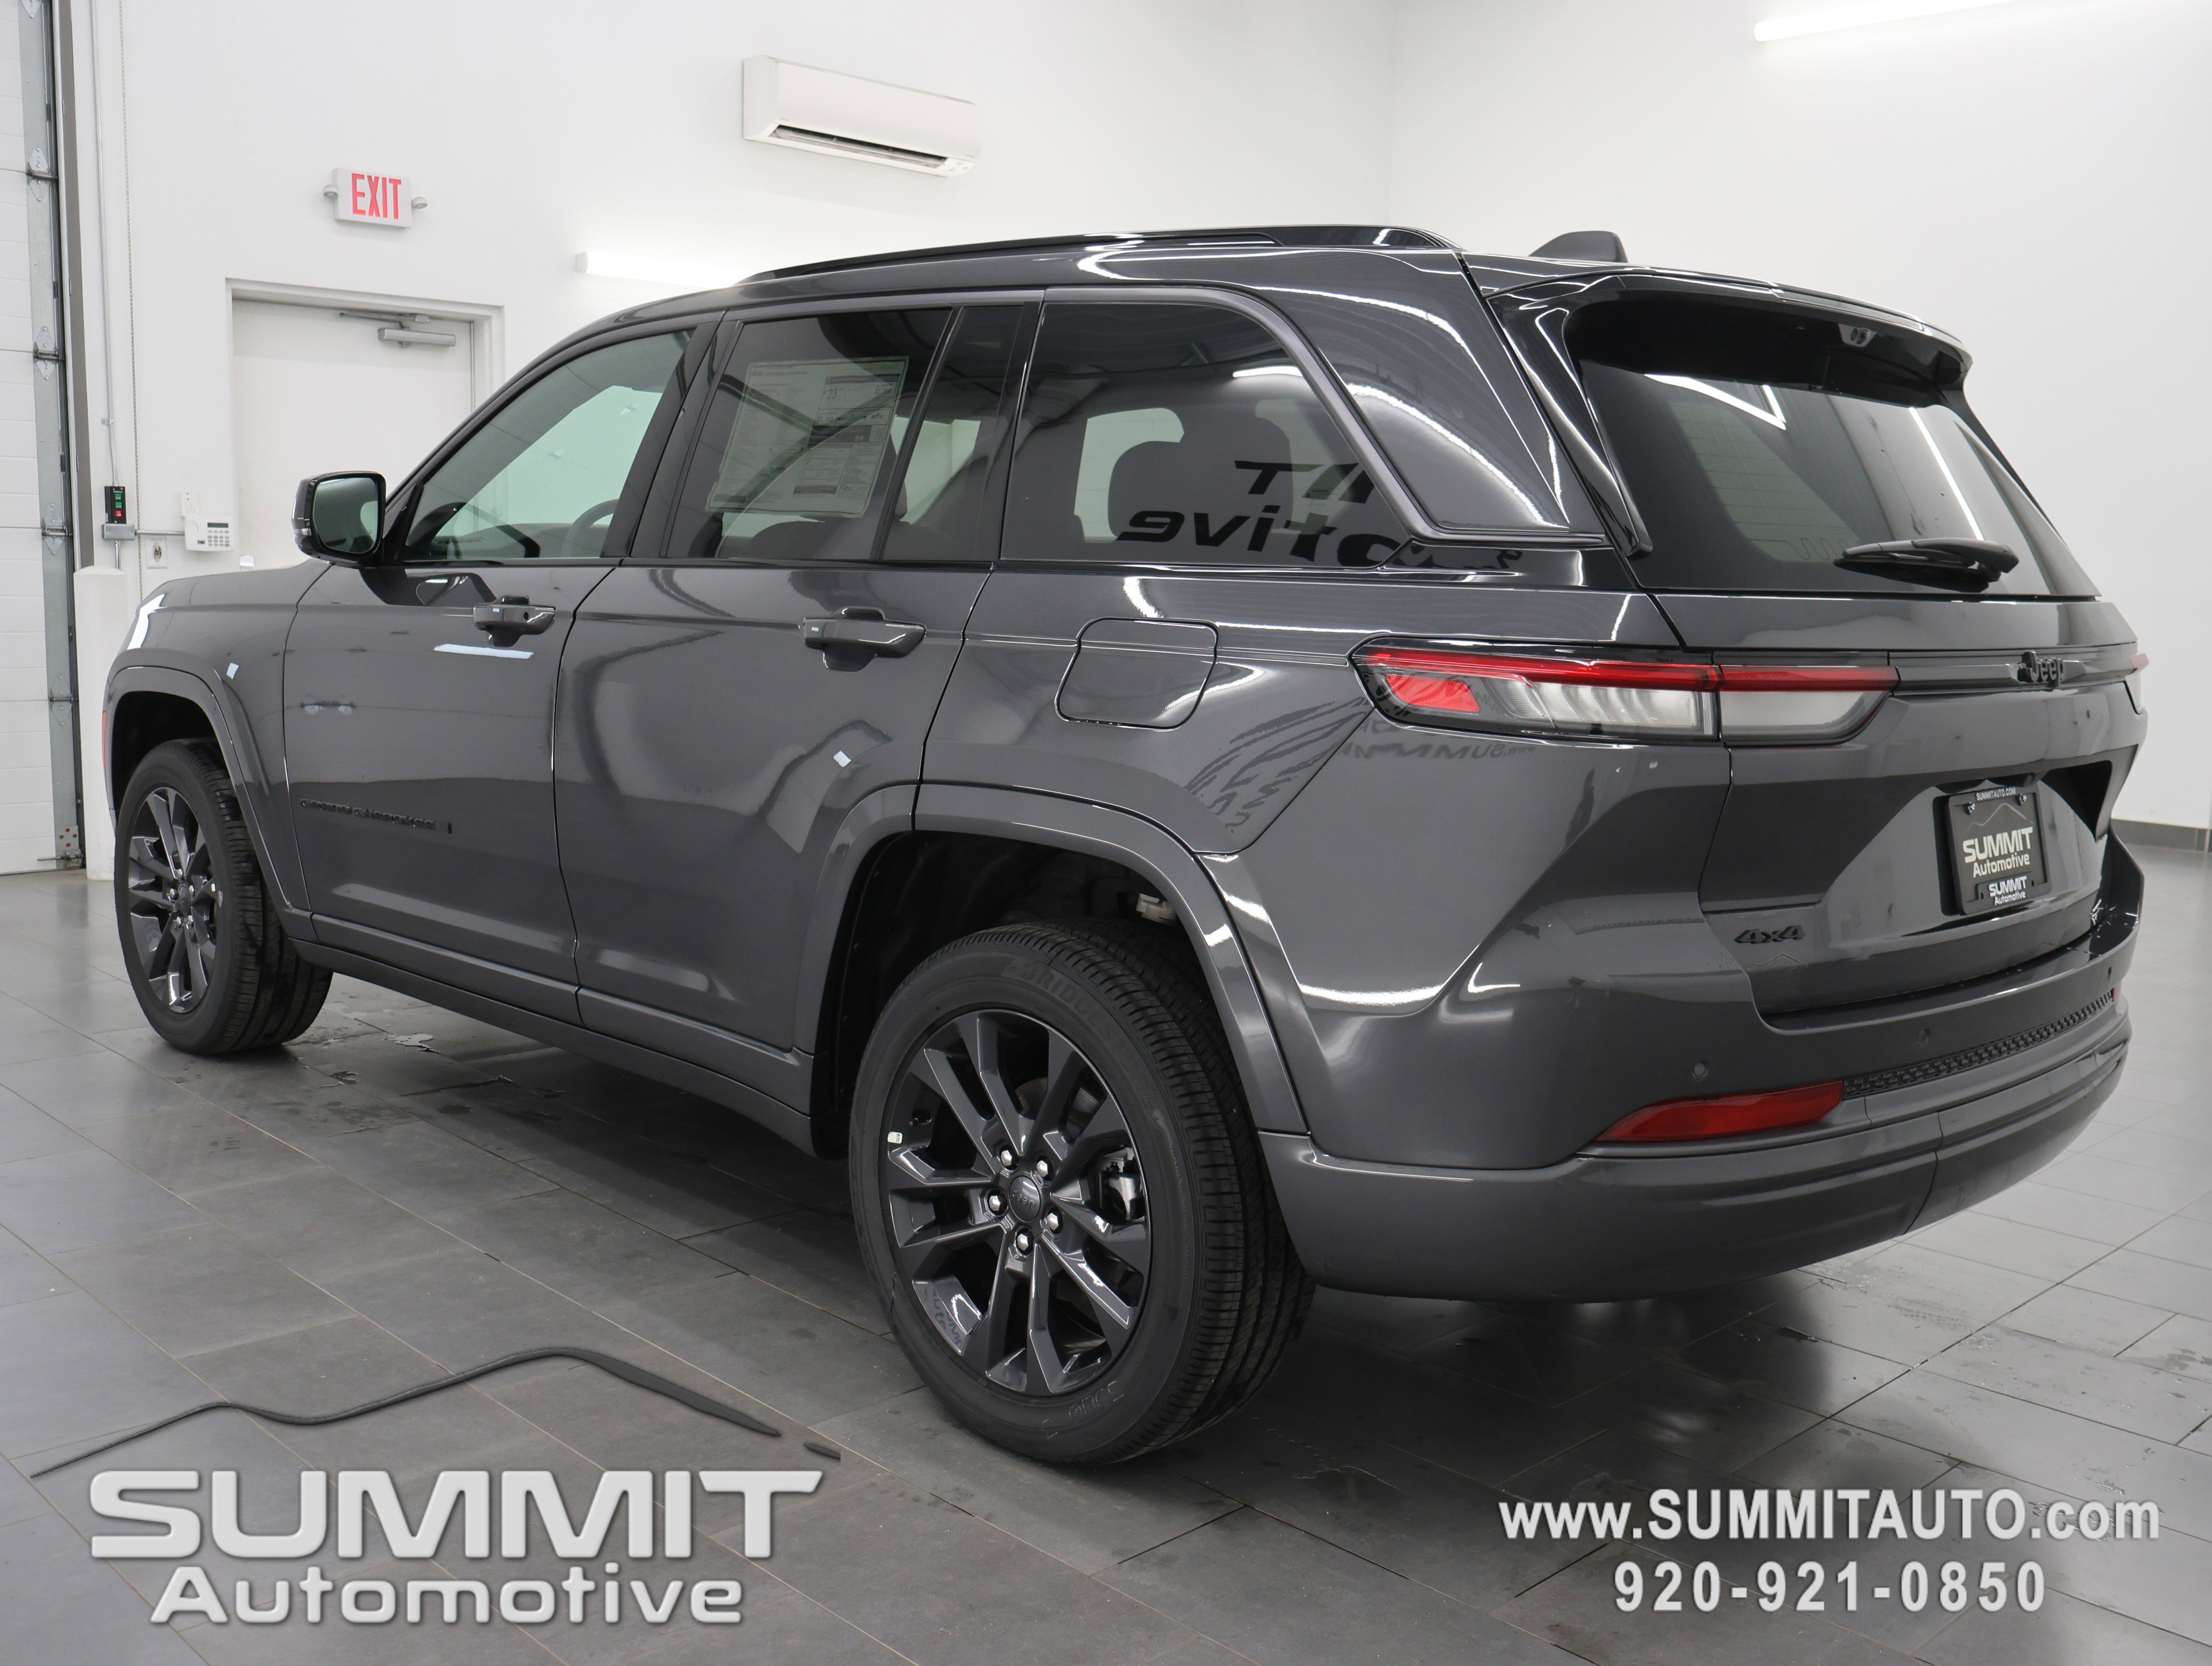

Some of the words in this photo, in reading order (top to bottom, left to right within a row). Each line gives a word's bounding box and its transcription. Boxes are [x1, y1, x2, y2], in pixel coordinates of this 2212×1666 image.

[351, 173, 402, 220] EXIT
[2018, 649, 2064, 687] Jeep
[1976, 787, 2016, 801] SUMMITAUTO.COM
[353, 808, 437, 830] CHEROKEE
[1962, 826, 2033, 863] SUMMIT
[1972, 852, 2030, 878] Automotive
[1988, 875, 2028, 897] SUMMIT
[1994, 890, 2026, 906] Automotive
[1734, 925, 1805, 944] 4x4
[1017, 960, 1161, 1110] BRIDGESTONE
[1012, 1190, 1036, 1210] Jeep
